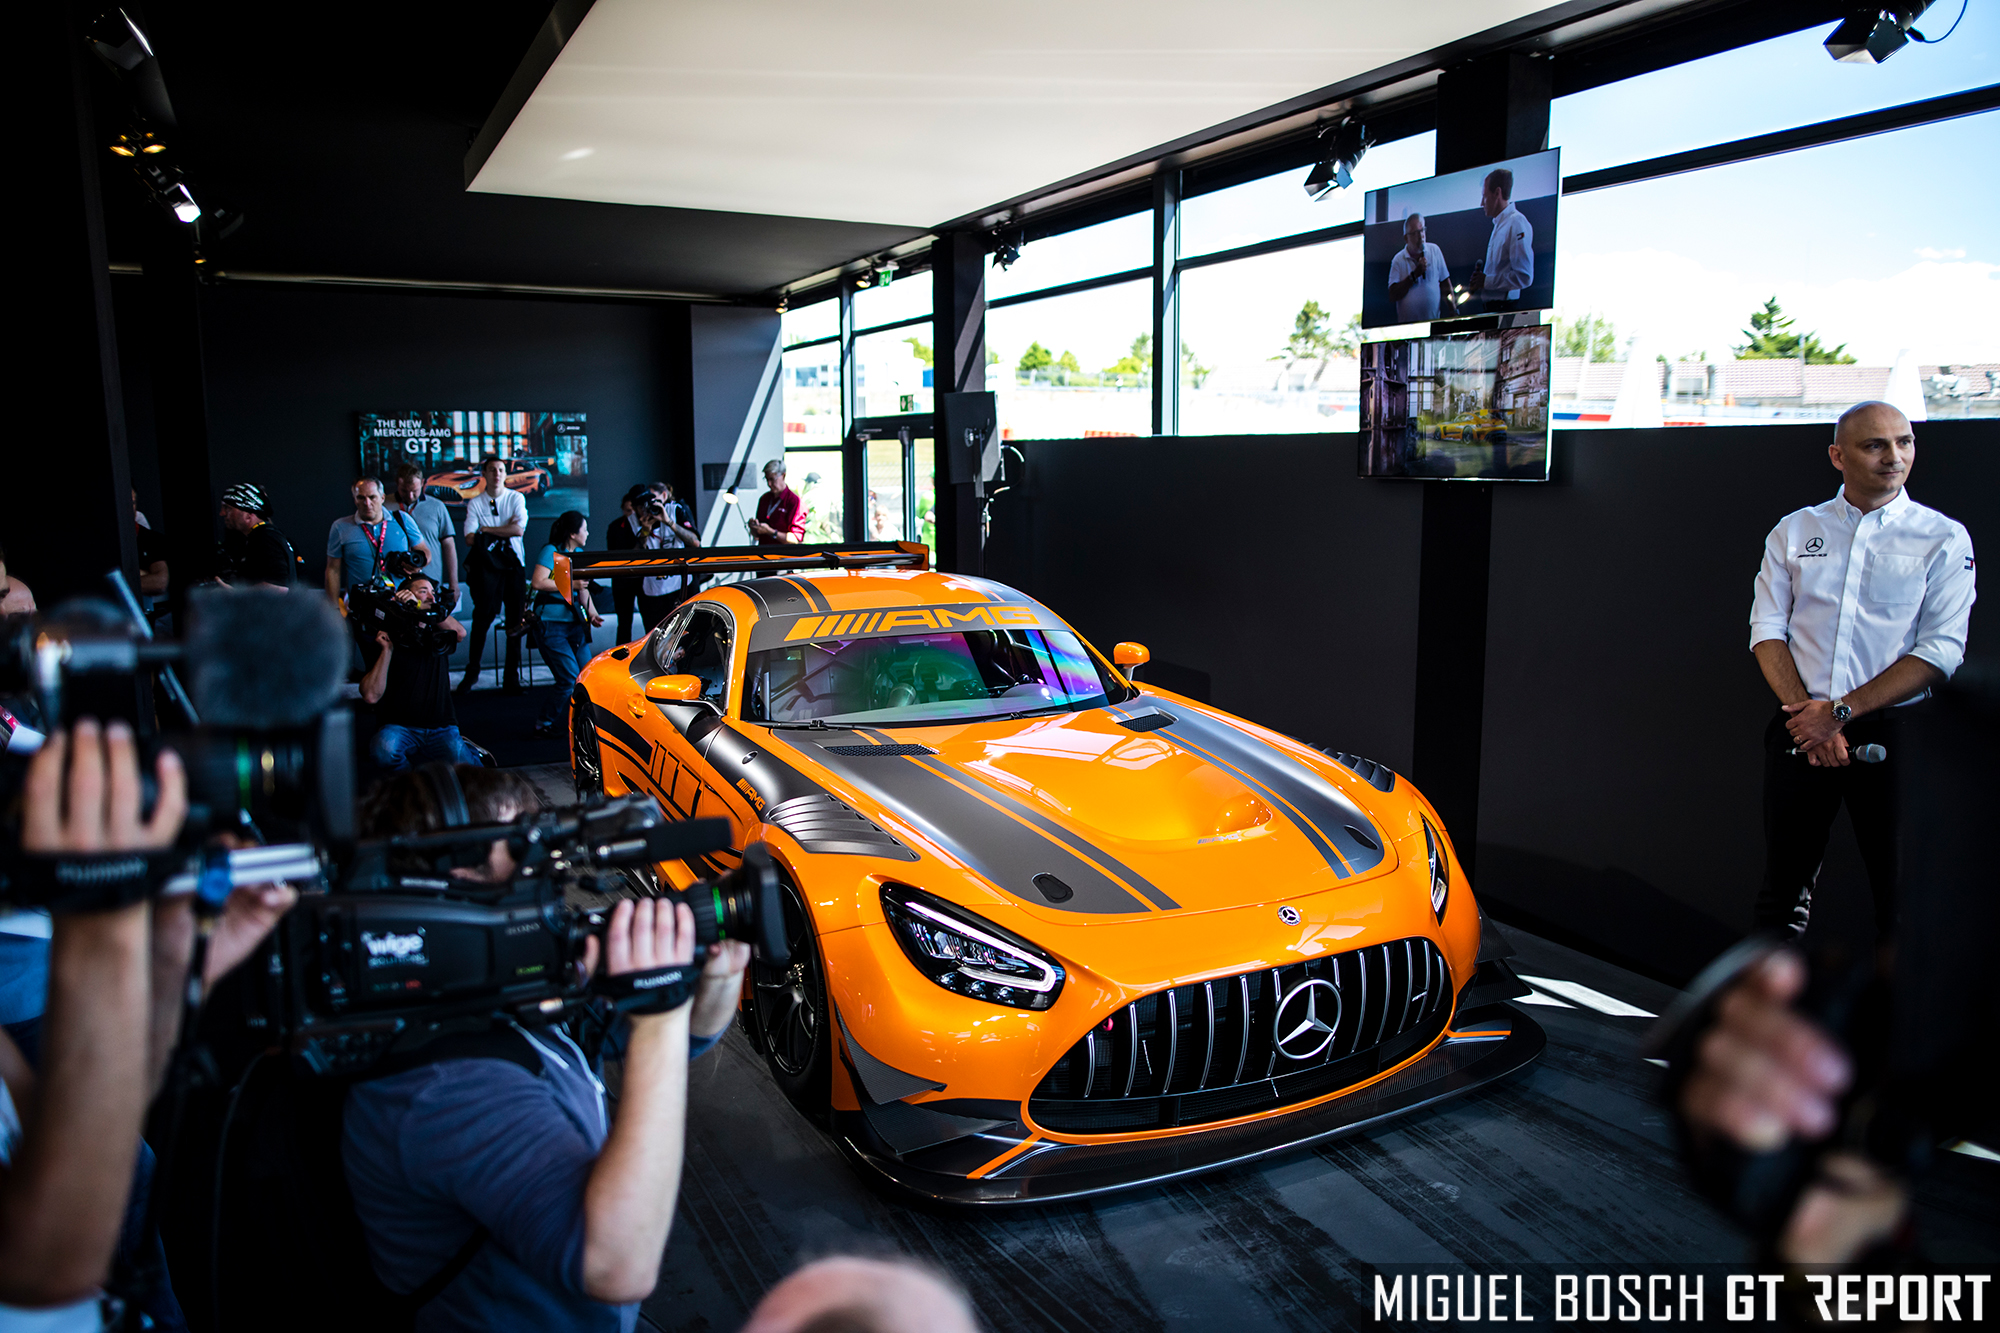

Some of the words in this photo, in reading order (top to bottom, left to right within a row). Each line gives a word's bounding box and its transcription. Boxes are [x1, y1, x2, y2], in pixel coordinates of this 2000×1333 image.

[376, 420, 396, 428] THE
[399, 420, 422, 428] NEW
[374, 428, 451, 437] MERCEDES-AMG
[405, 438, 442, 454] GT3
[877, 606, 1041, 632] AMG
